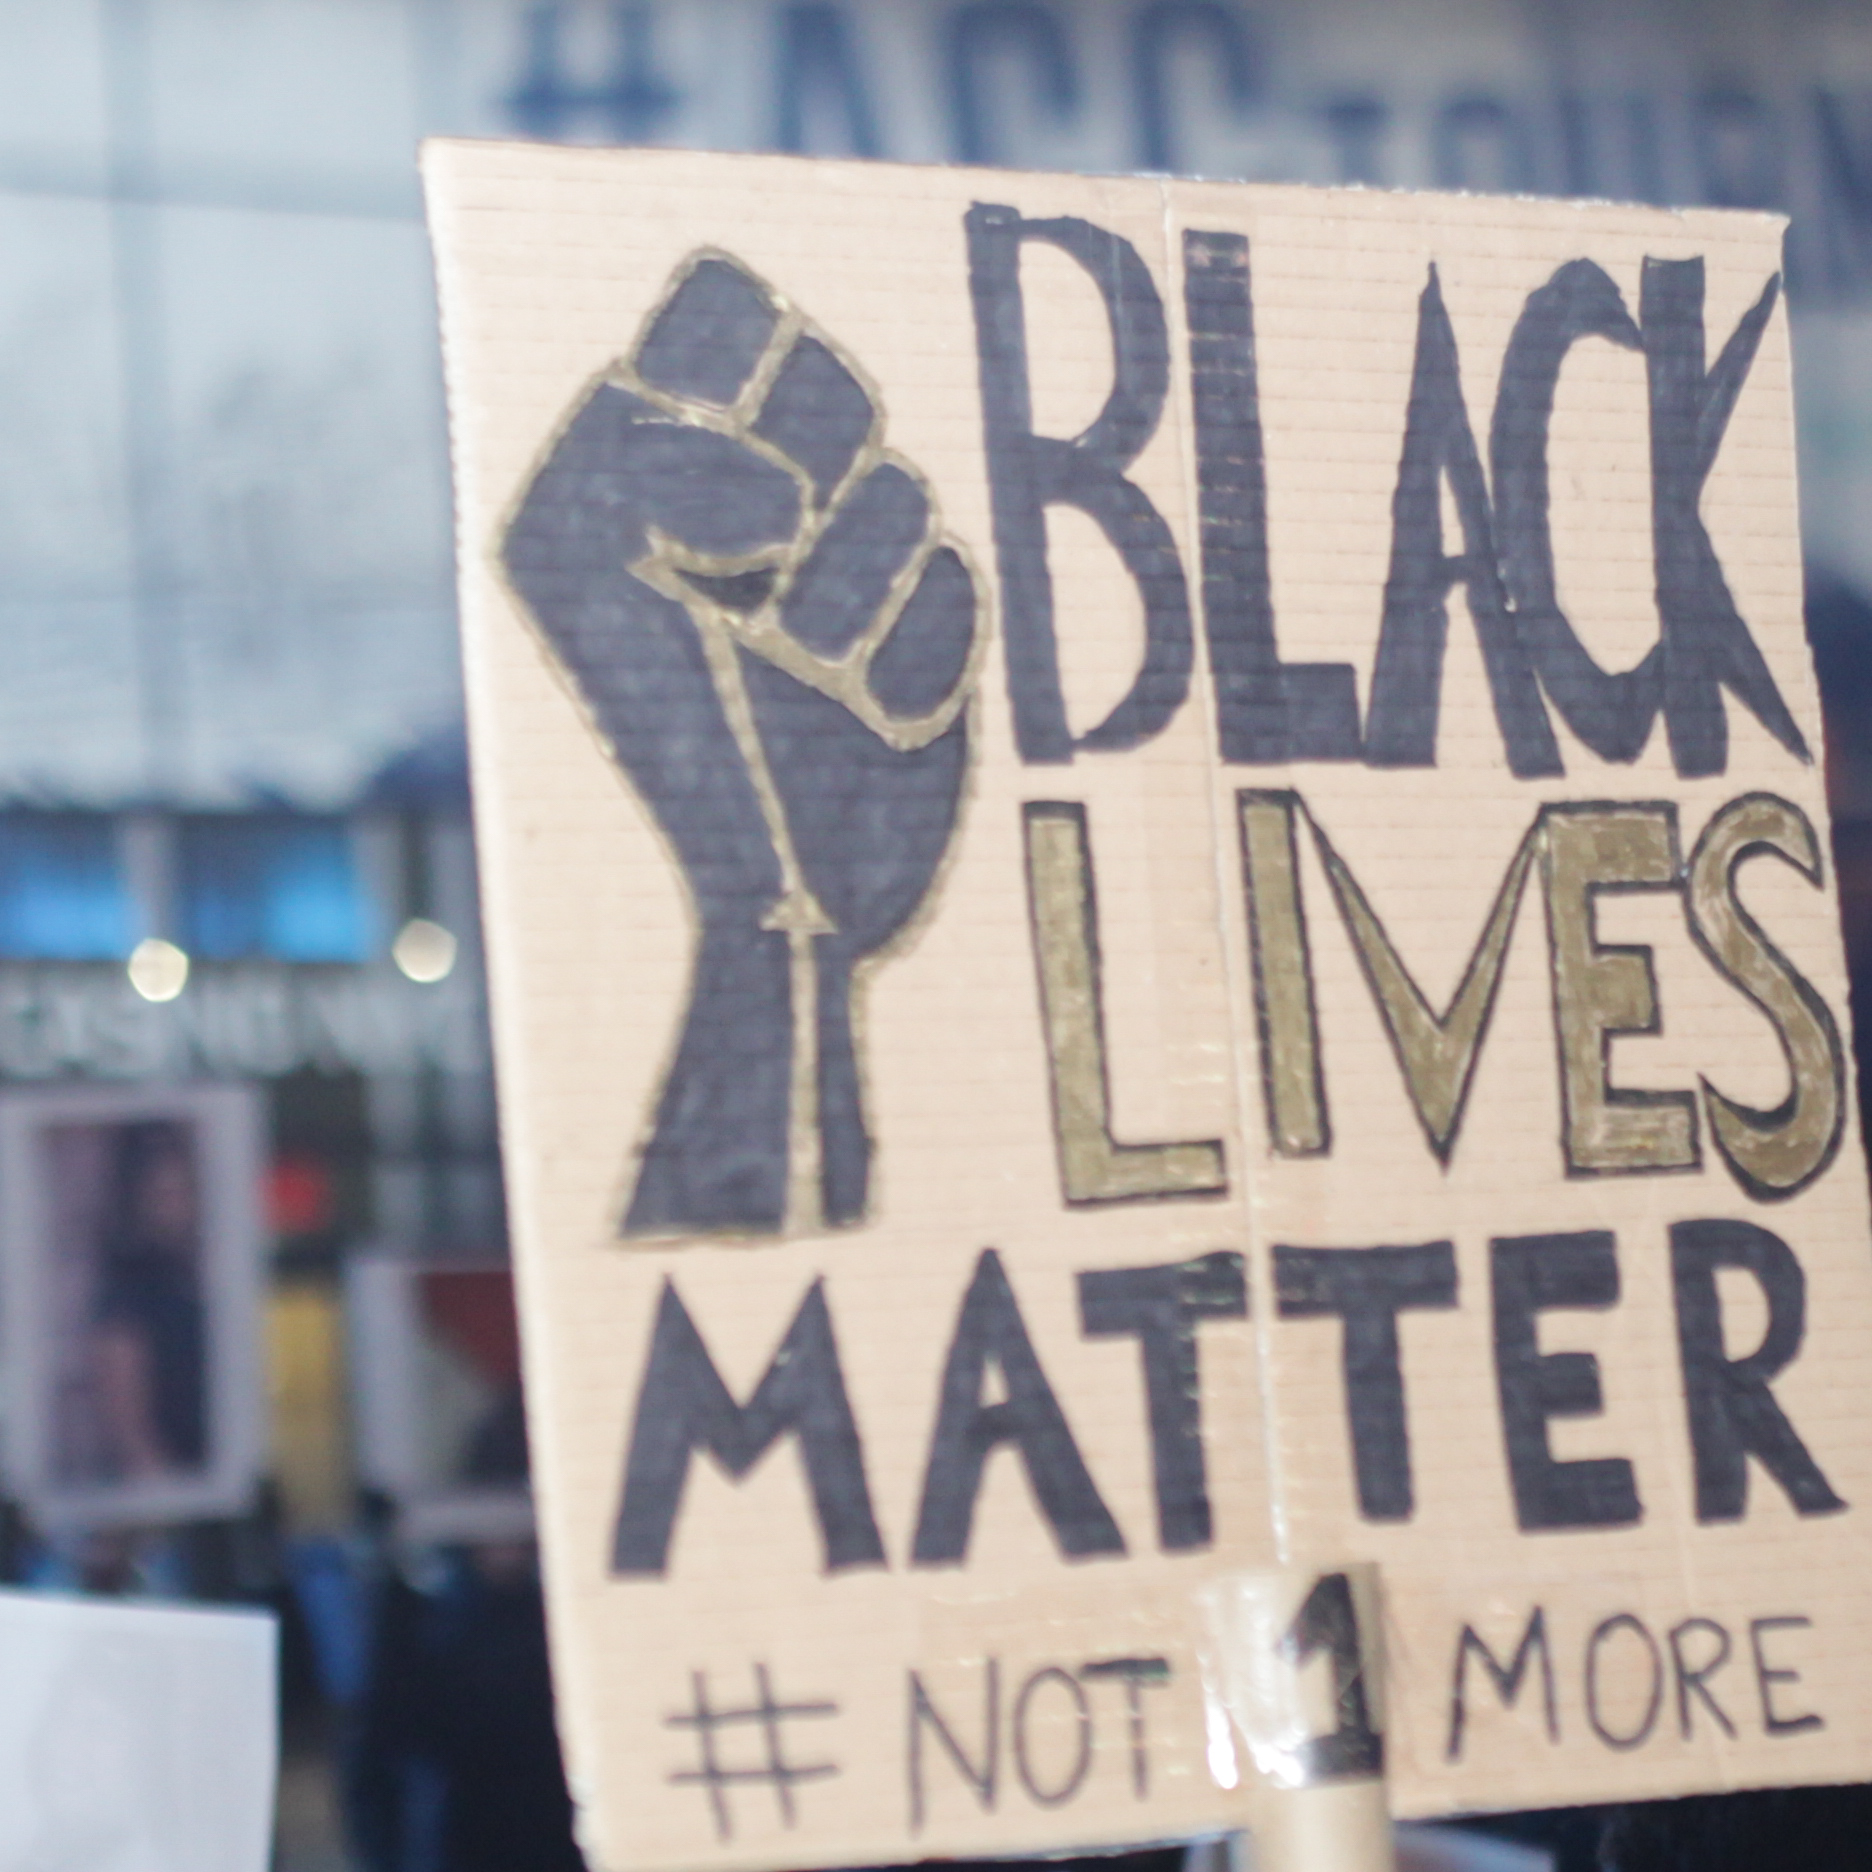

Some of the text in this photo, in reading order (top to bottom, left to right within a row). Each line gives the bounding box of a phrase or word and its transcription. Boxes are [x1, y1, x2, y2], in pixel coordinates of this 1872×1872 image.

[963, 200, 1814, 781] BLACK
[1018, 788, 1845, 1209] LIVES
[604, 1218, 1847, 1580] MATTER
[906, 1652, 1172, 1842] NOT
[1278, 1570, 1386, 1785] 1
[1444, 1603, 1827, 1764] MORE
